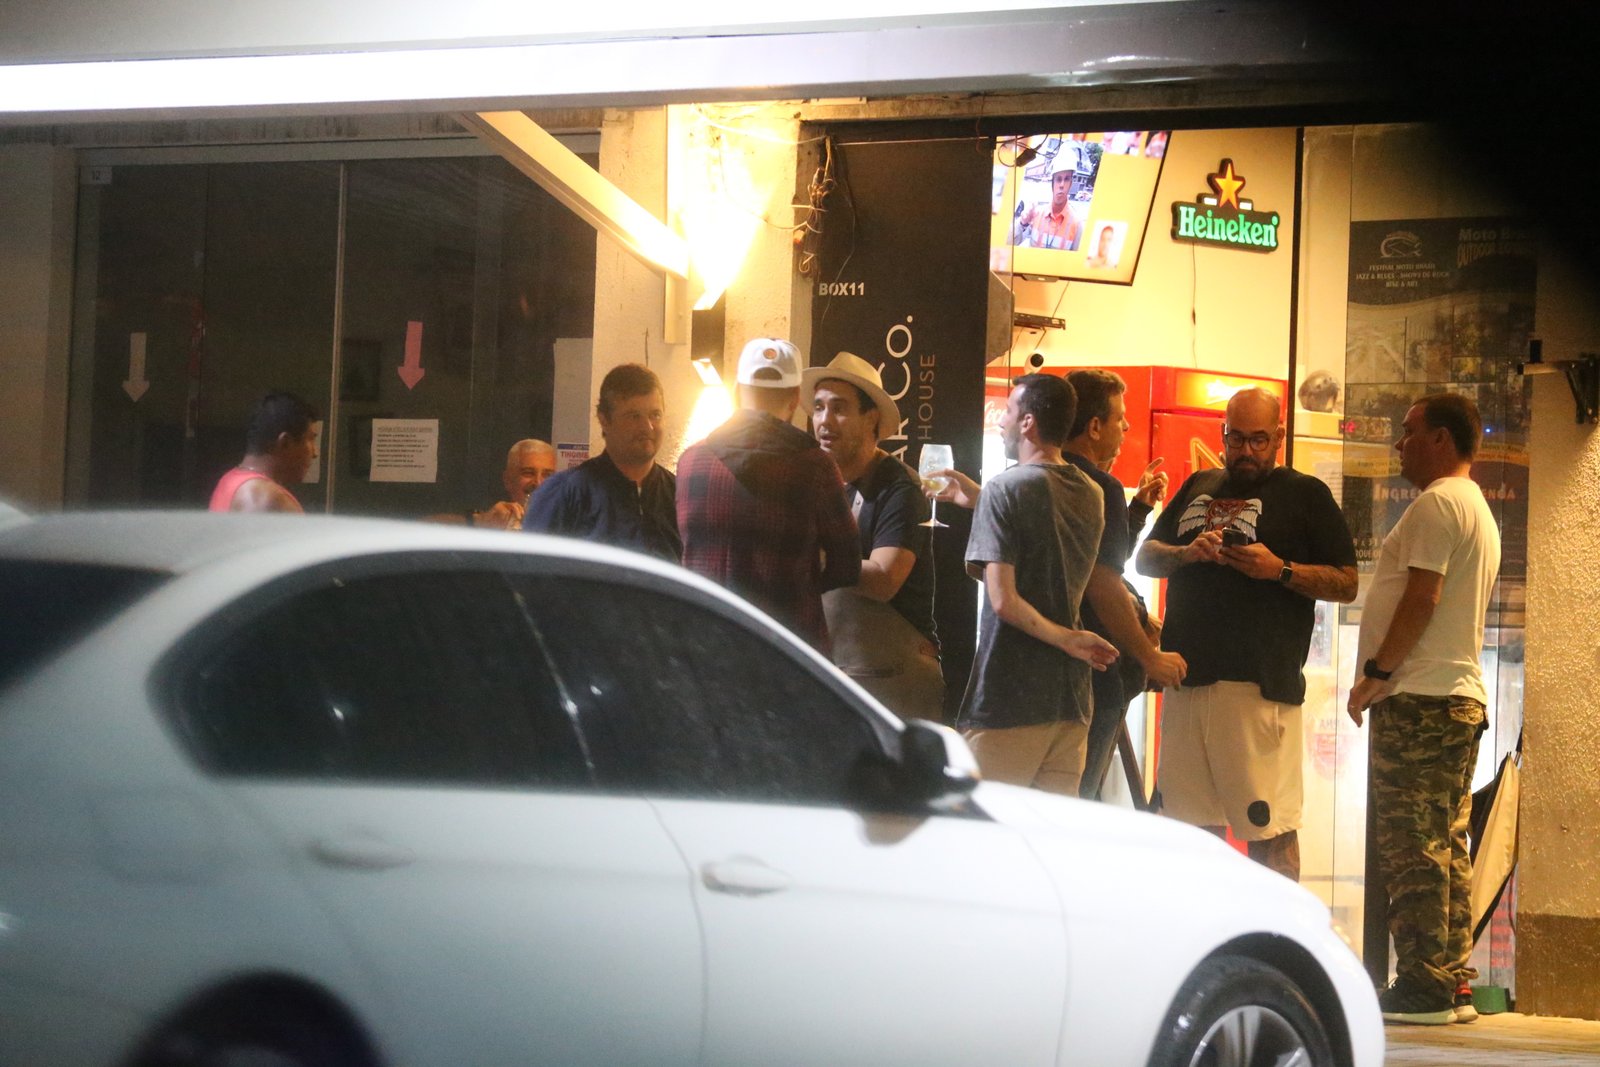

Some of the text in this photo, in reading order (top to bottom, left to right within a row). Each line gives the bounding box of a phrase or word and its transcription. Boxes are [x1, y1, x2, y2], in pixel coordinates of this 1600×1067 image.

[1178, 206, 1277, 247] Heineken
[819, 282, 865, 296] BOX11
[918, 354, 936, 440] HOUSE
